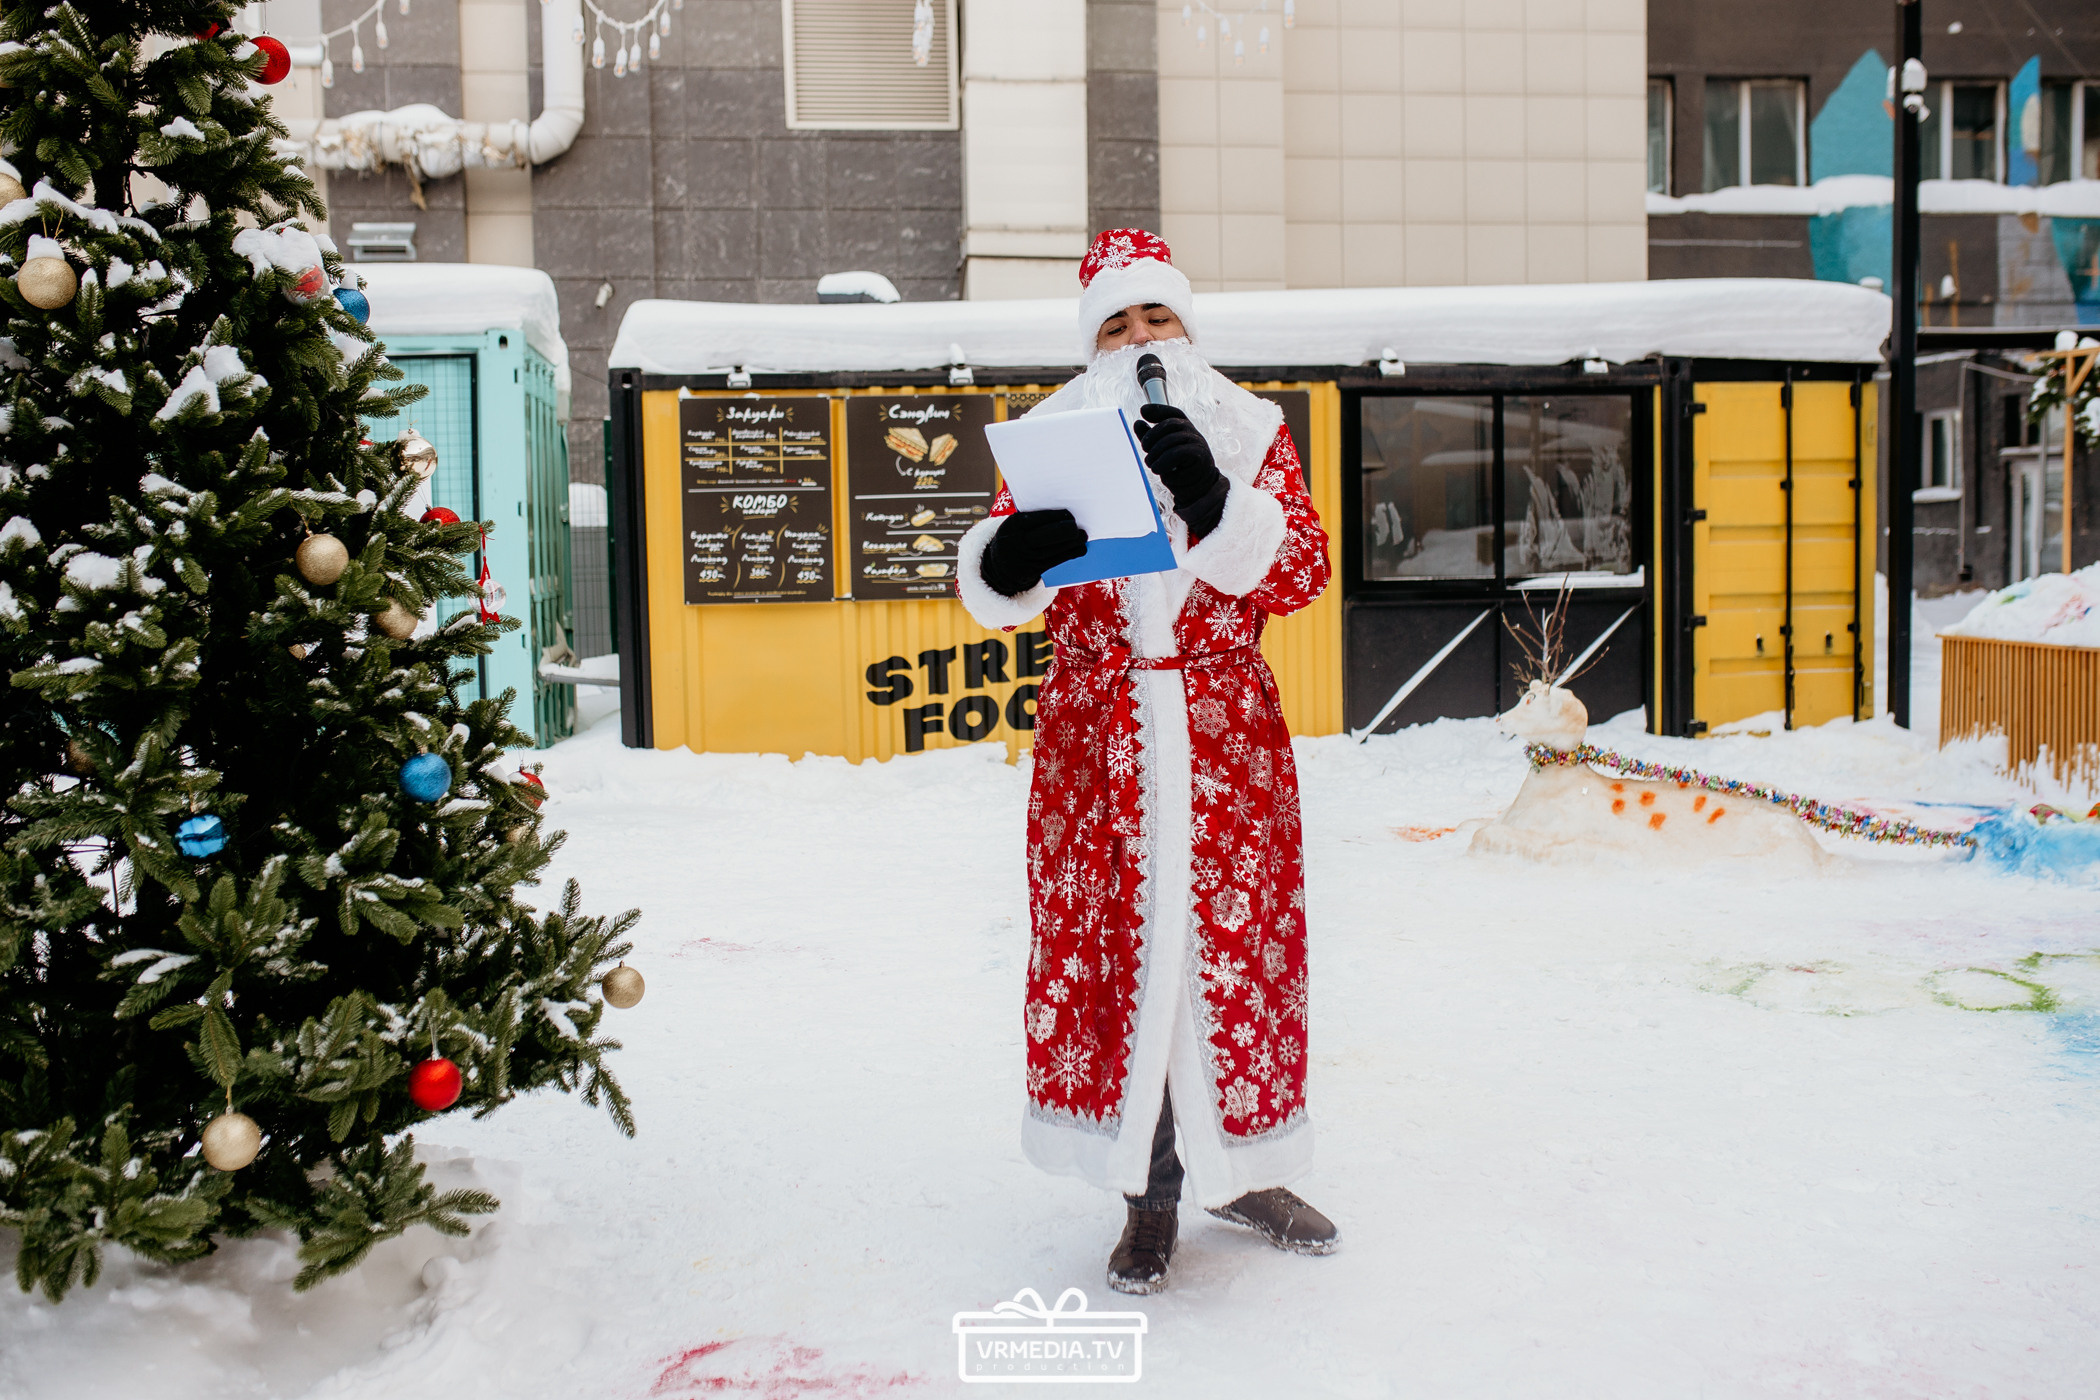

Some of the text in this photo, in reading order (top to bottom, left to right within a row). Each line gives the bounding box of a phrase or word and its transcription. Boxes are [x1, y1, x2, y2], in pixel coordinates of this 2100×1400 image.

[726, 406, 785, 424] Закуски
[888, 404, 950, 425] Сэндвич
[732, 494, 788, 509] КОМБО
